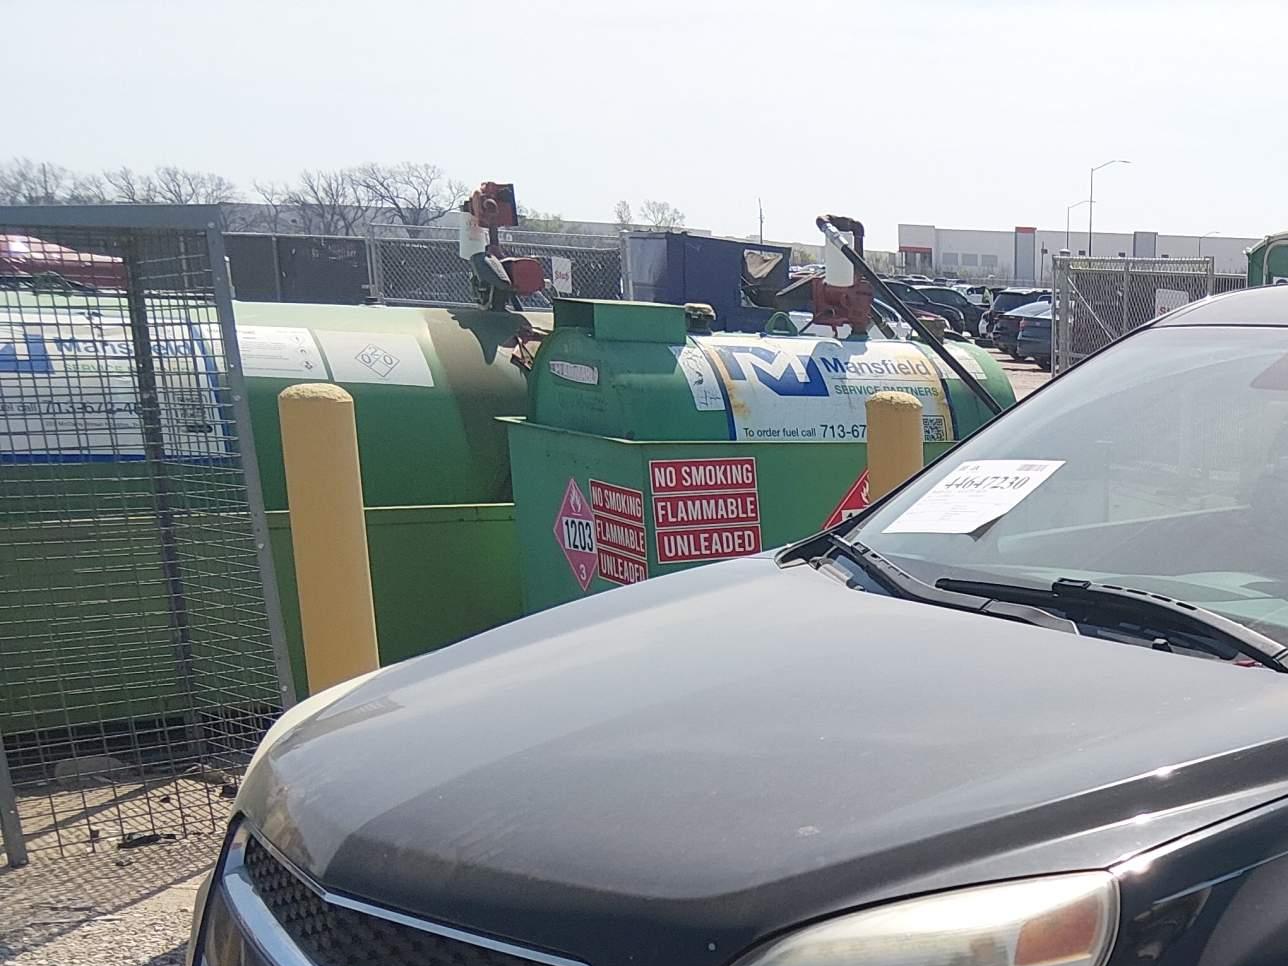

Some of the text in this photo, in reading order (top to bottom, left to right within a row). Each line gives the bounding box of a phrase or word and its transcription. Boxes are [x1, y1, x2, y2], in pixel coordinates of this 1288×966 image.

[820, 356, 931, 376] Mansfield
[834, 384, 879, 395] SERVICE
[744, 424, 866, 439] To order fuel call 713-67
[654, 464, 753, 488] NO SMOKING
[944, 475, 1031, 490] 44647230
[591, 486, 642, 518] NO SMOKING
[657, 497, 756, 523] FLAMMABLE
[564, 519, 593, 552] 1203
[596, 520, 645, 553] FLAMMABLE
[663, 530, 756, 557] UNLEADED
[579, 563, 587, 581] 3
[600, 553, 646, 584] UNLEADED
